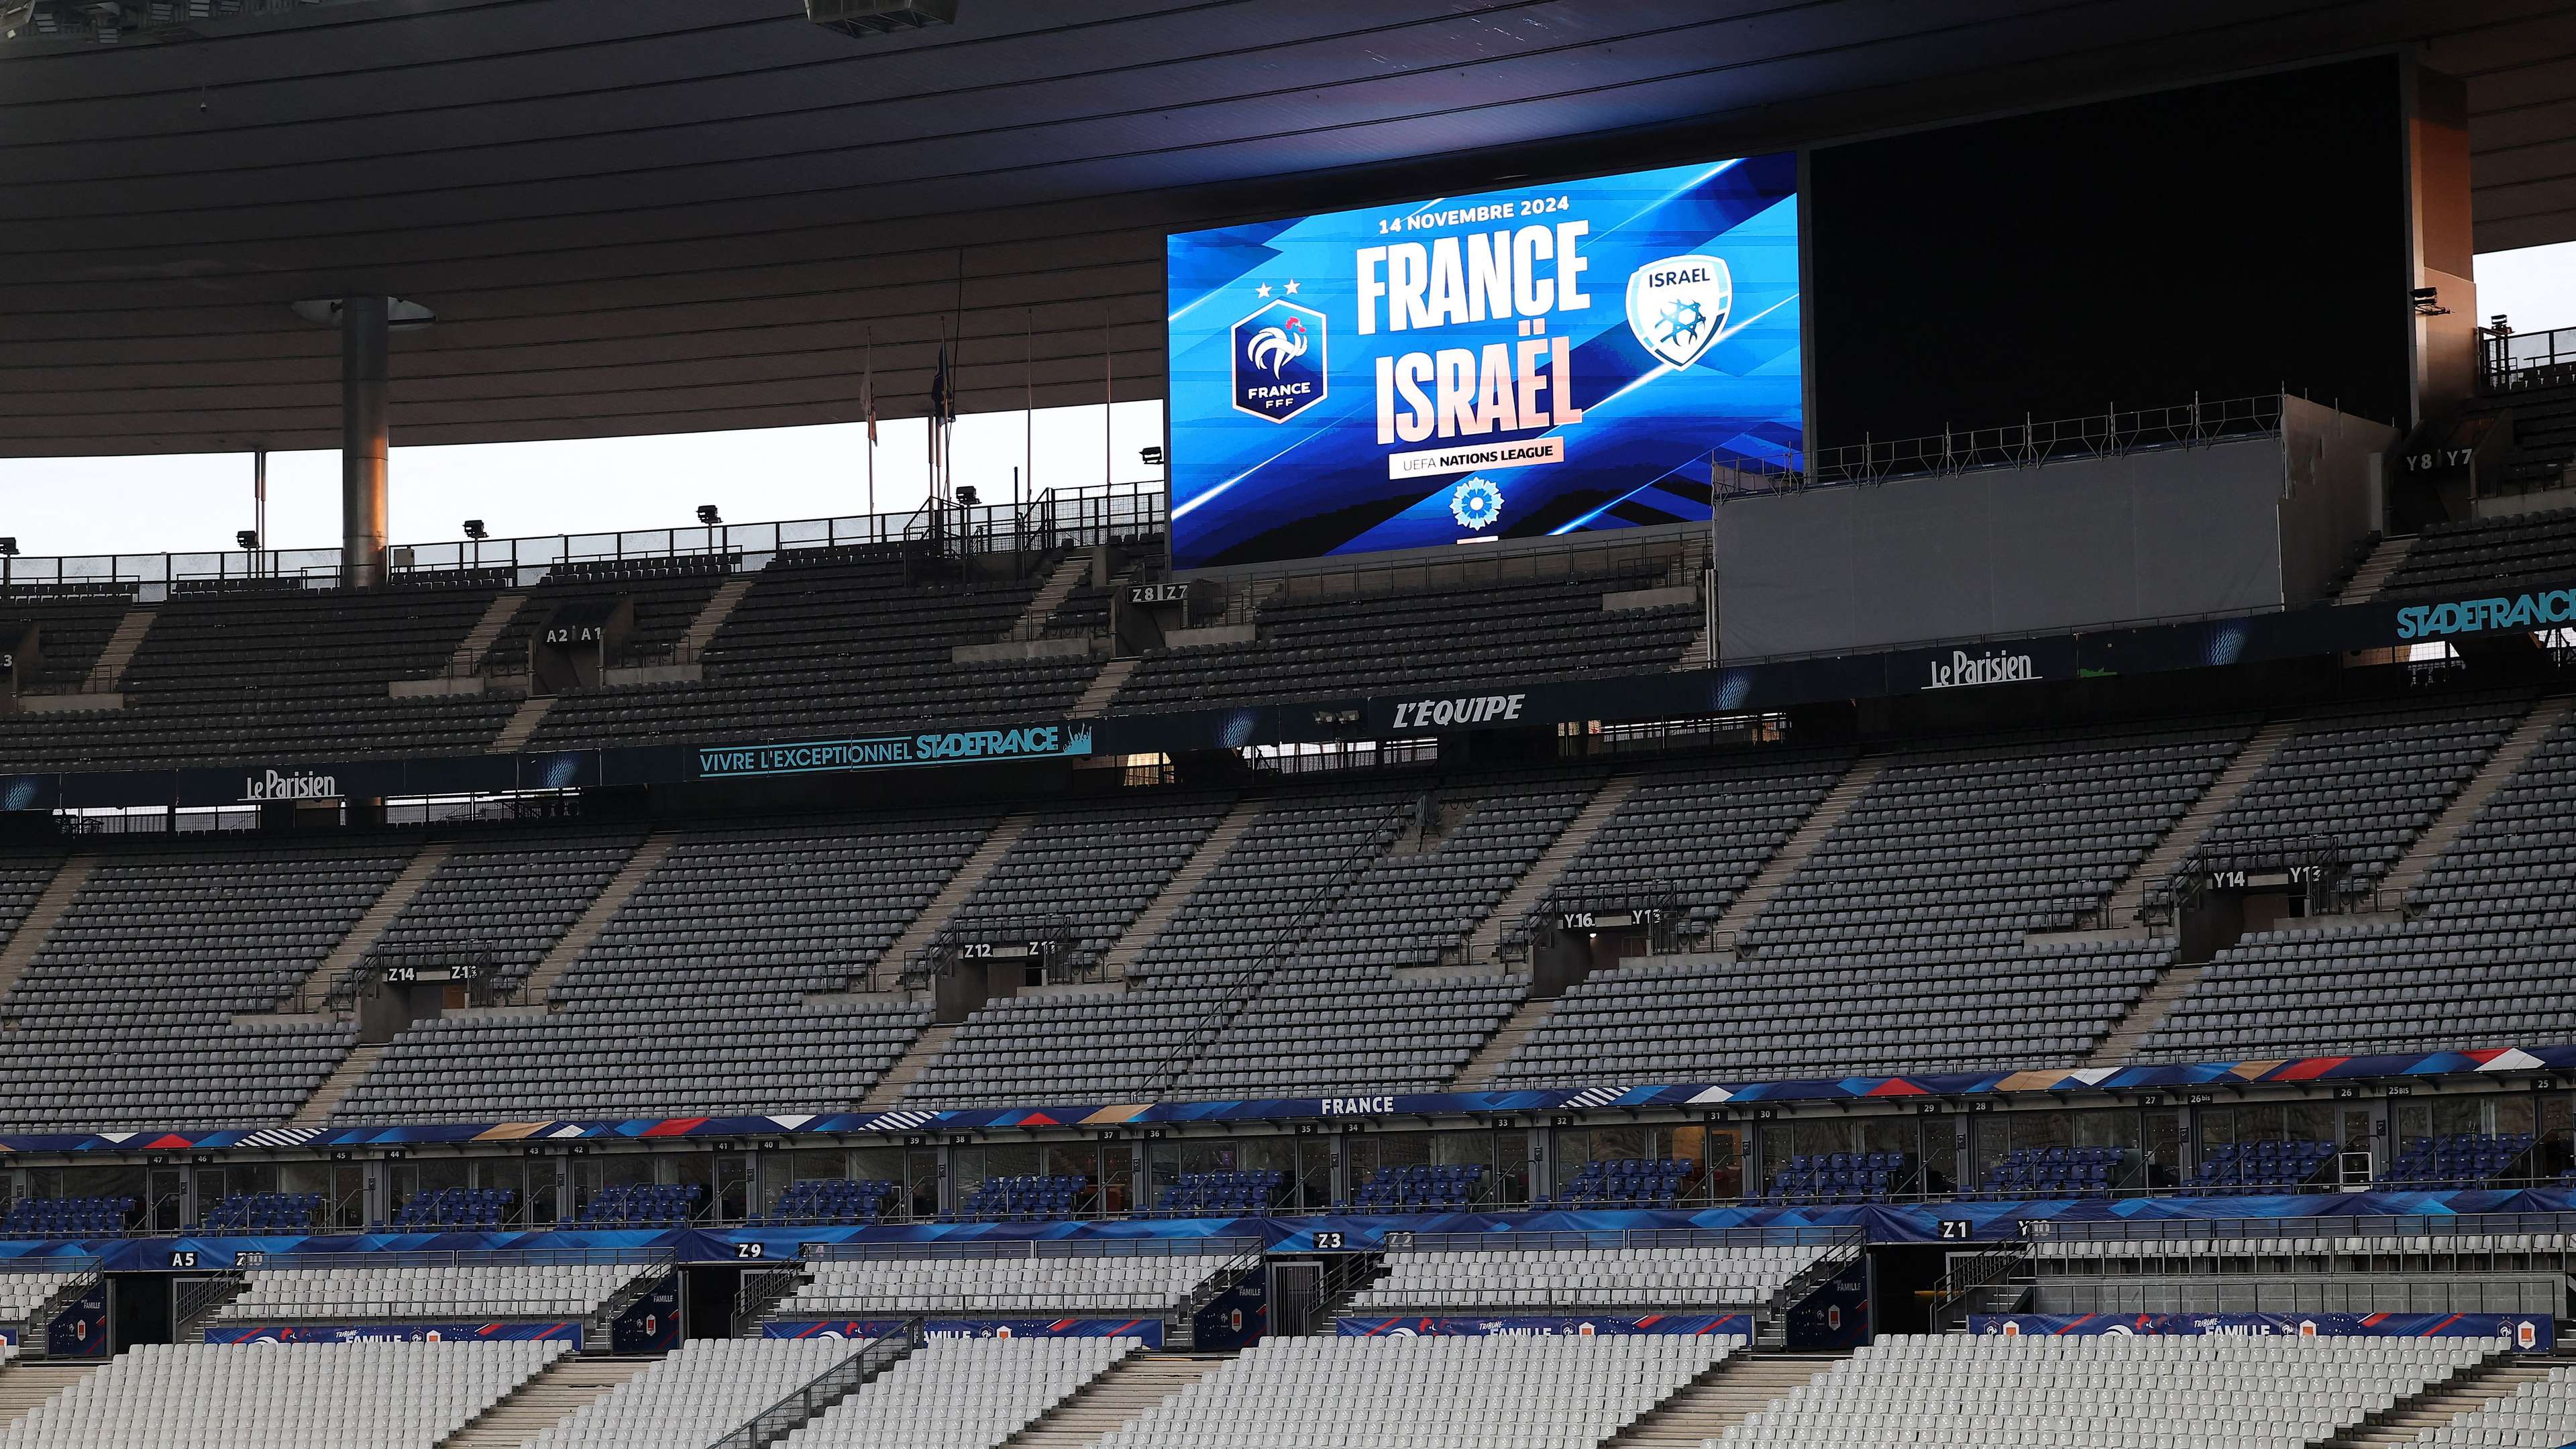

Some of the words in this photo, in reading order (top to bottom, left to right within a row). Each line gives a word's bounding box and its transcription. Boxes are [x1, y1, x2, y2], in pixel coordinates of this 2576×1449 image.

[1379, 218, 1401, 234] 14
[1408, 205, 1514, 230] NOVEMBRE
[1521, 196, 1569, 216] 2024
[1356, 220, 1591, 336] FRANCE
[1649, 268, 1711, 288] ISRAEL
[1375, 318, 1583, 445] ISRAËL
[1248, 382, 1311, 400] FRANCE
[1266, 398, 1294, 409] FFF
[1403, 458, 1437, 472] UEFA
[1440, 451, 1498, 468] NATIONS
[1501, 445, 1554, 462] LEAGUE
[1931, 661, 1951, 688] Le
[1953, 649, 2033, 686] Parisien
[700, 752, 755, 772] VIVRE
[761, 743, 913, 769] L'EXCEPTIONNEL
[248, 777, 264, 799] Le
[266, 769, 336, 798] Parisien
[2214, 871, 2245, 888] Y14
[1564, 912, 1593, 928] Y16
[388, 967, 415, 981] Z14
[2145, 1096, 2156, 1104] 27
[2191, 1095, 2201, 1103] 26
[2341, 1089, 2352, 1097] 26
[1322, 1096, 1395, 1115] FRANCE
[1924, 1104, 1934, 1112] 29
[1761, 1110, 1770, 1118] 30
[1239, 1288, 1261, 1297] FAMILLE
[1479, 1322, 1503, 1331] TRIBUNE
[2194, 1318, 2218, 1328] TRIBUNE
[335, 1329, 359, 1338] TRIBUNE
